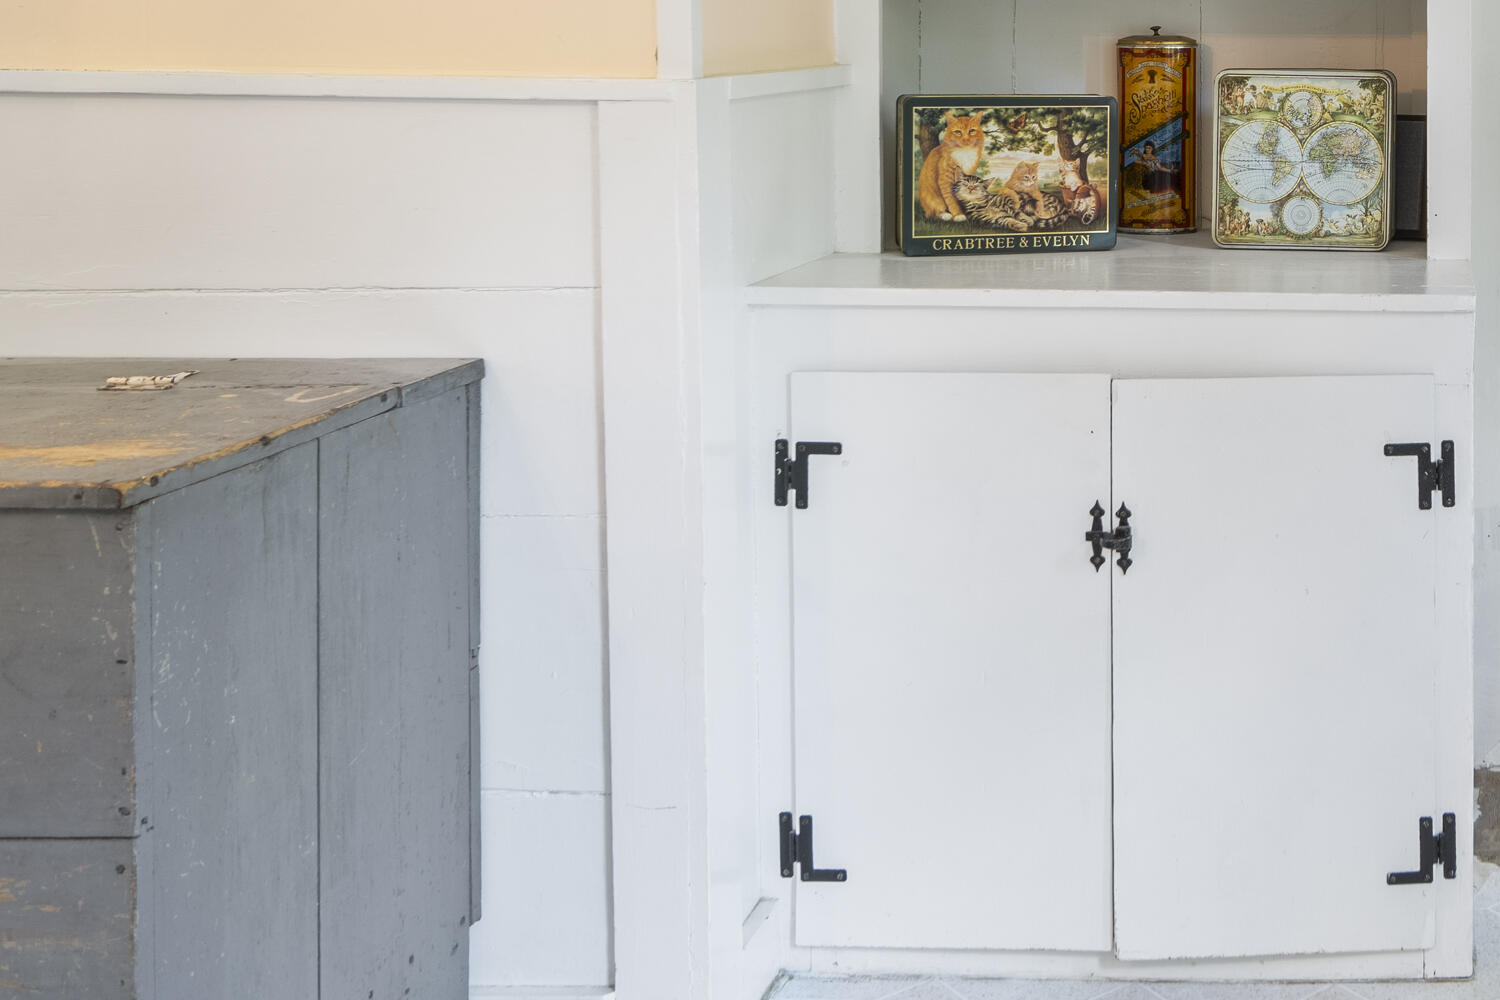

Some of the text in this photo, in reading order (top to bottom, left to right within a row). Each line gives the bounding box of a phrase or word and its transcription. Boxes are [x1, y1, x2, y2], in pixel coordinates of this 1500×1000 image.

[932, 234, 1090, 250] CRABTREE & EVELYN
